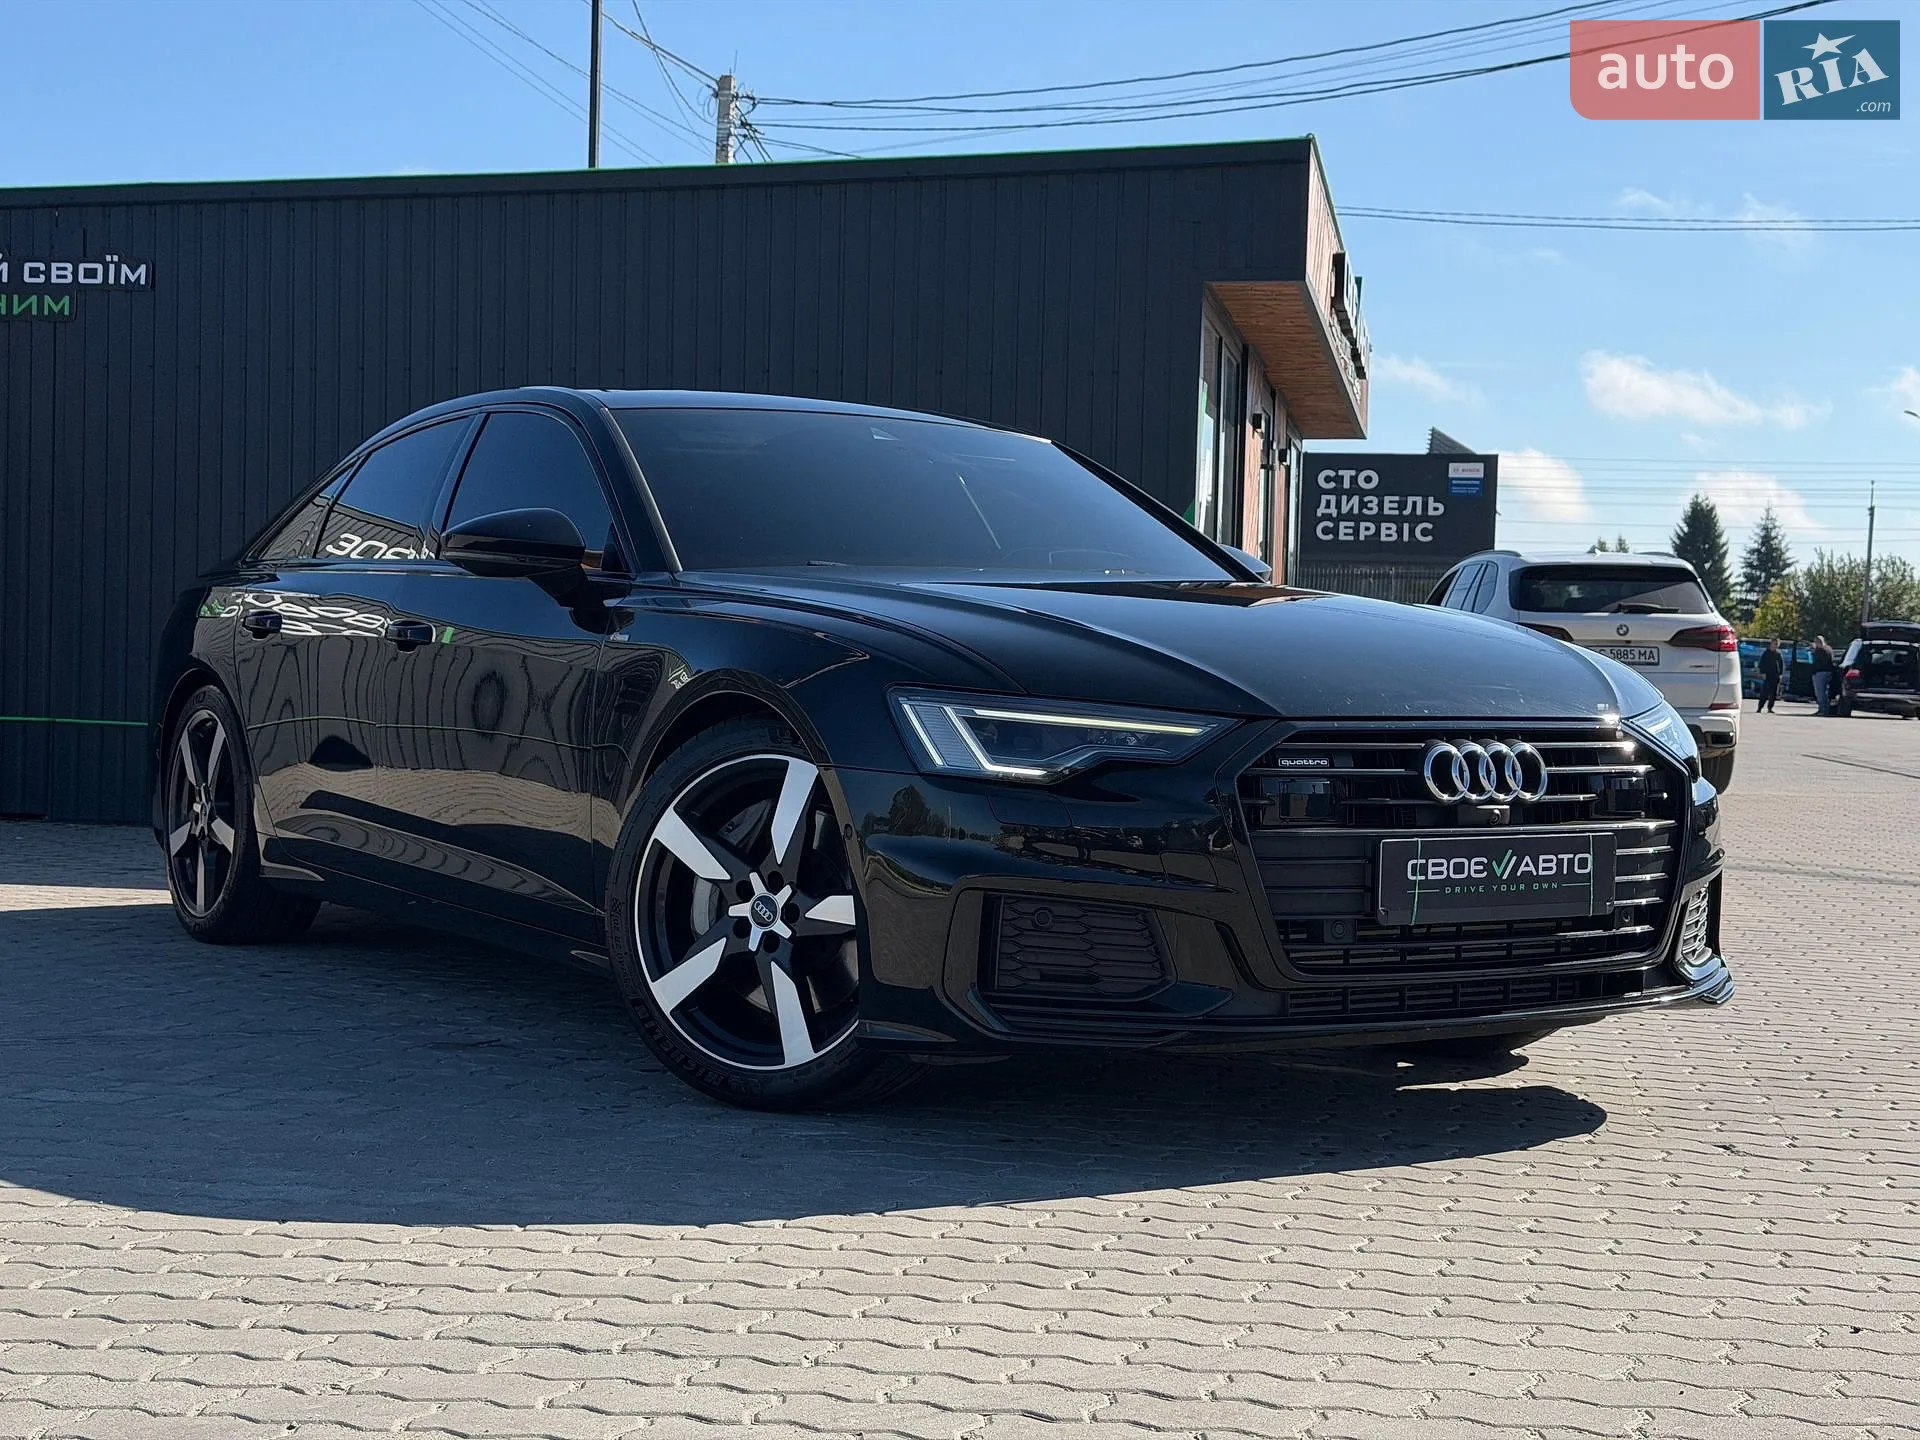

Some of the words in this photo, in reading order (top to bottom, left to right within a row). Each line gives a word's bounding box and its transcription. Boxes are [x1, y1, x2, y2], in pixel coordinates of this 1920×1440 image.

[23, 254, 147, 286] СВОЇМ
[1317, 469, 1380, 490] СТО
[1316, 494, 1445, 518] ДИЗЕЛЬ
[1315, 520, 1434, 542] СЕРВІС
[1445, 886, 1485, 894] DRIVE
[1492, 883, 1526, 892] YOUR
[1533, 882, 1559, 891] OWN
